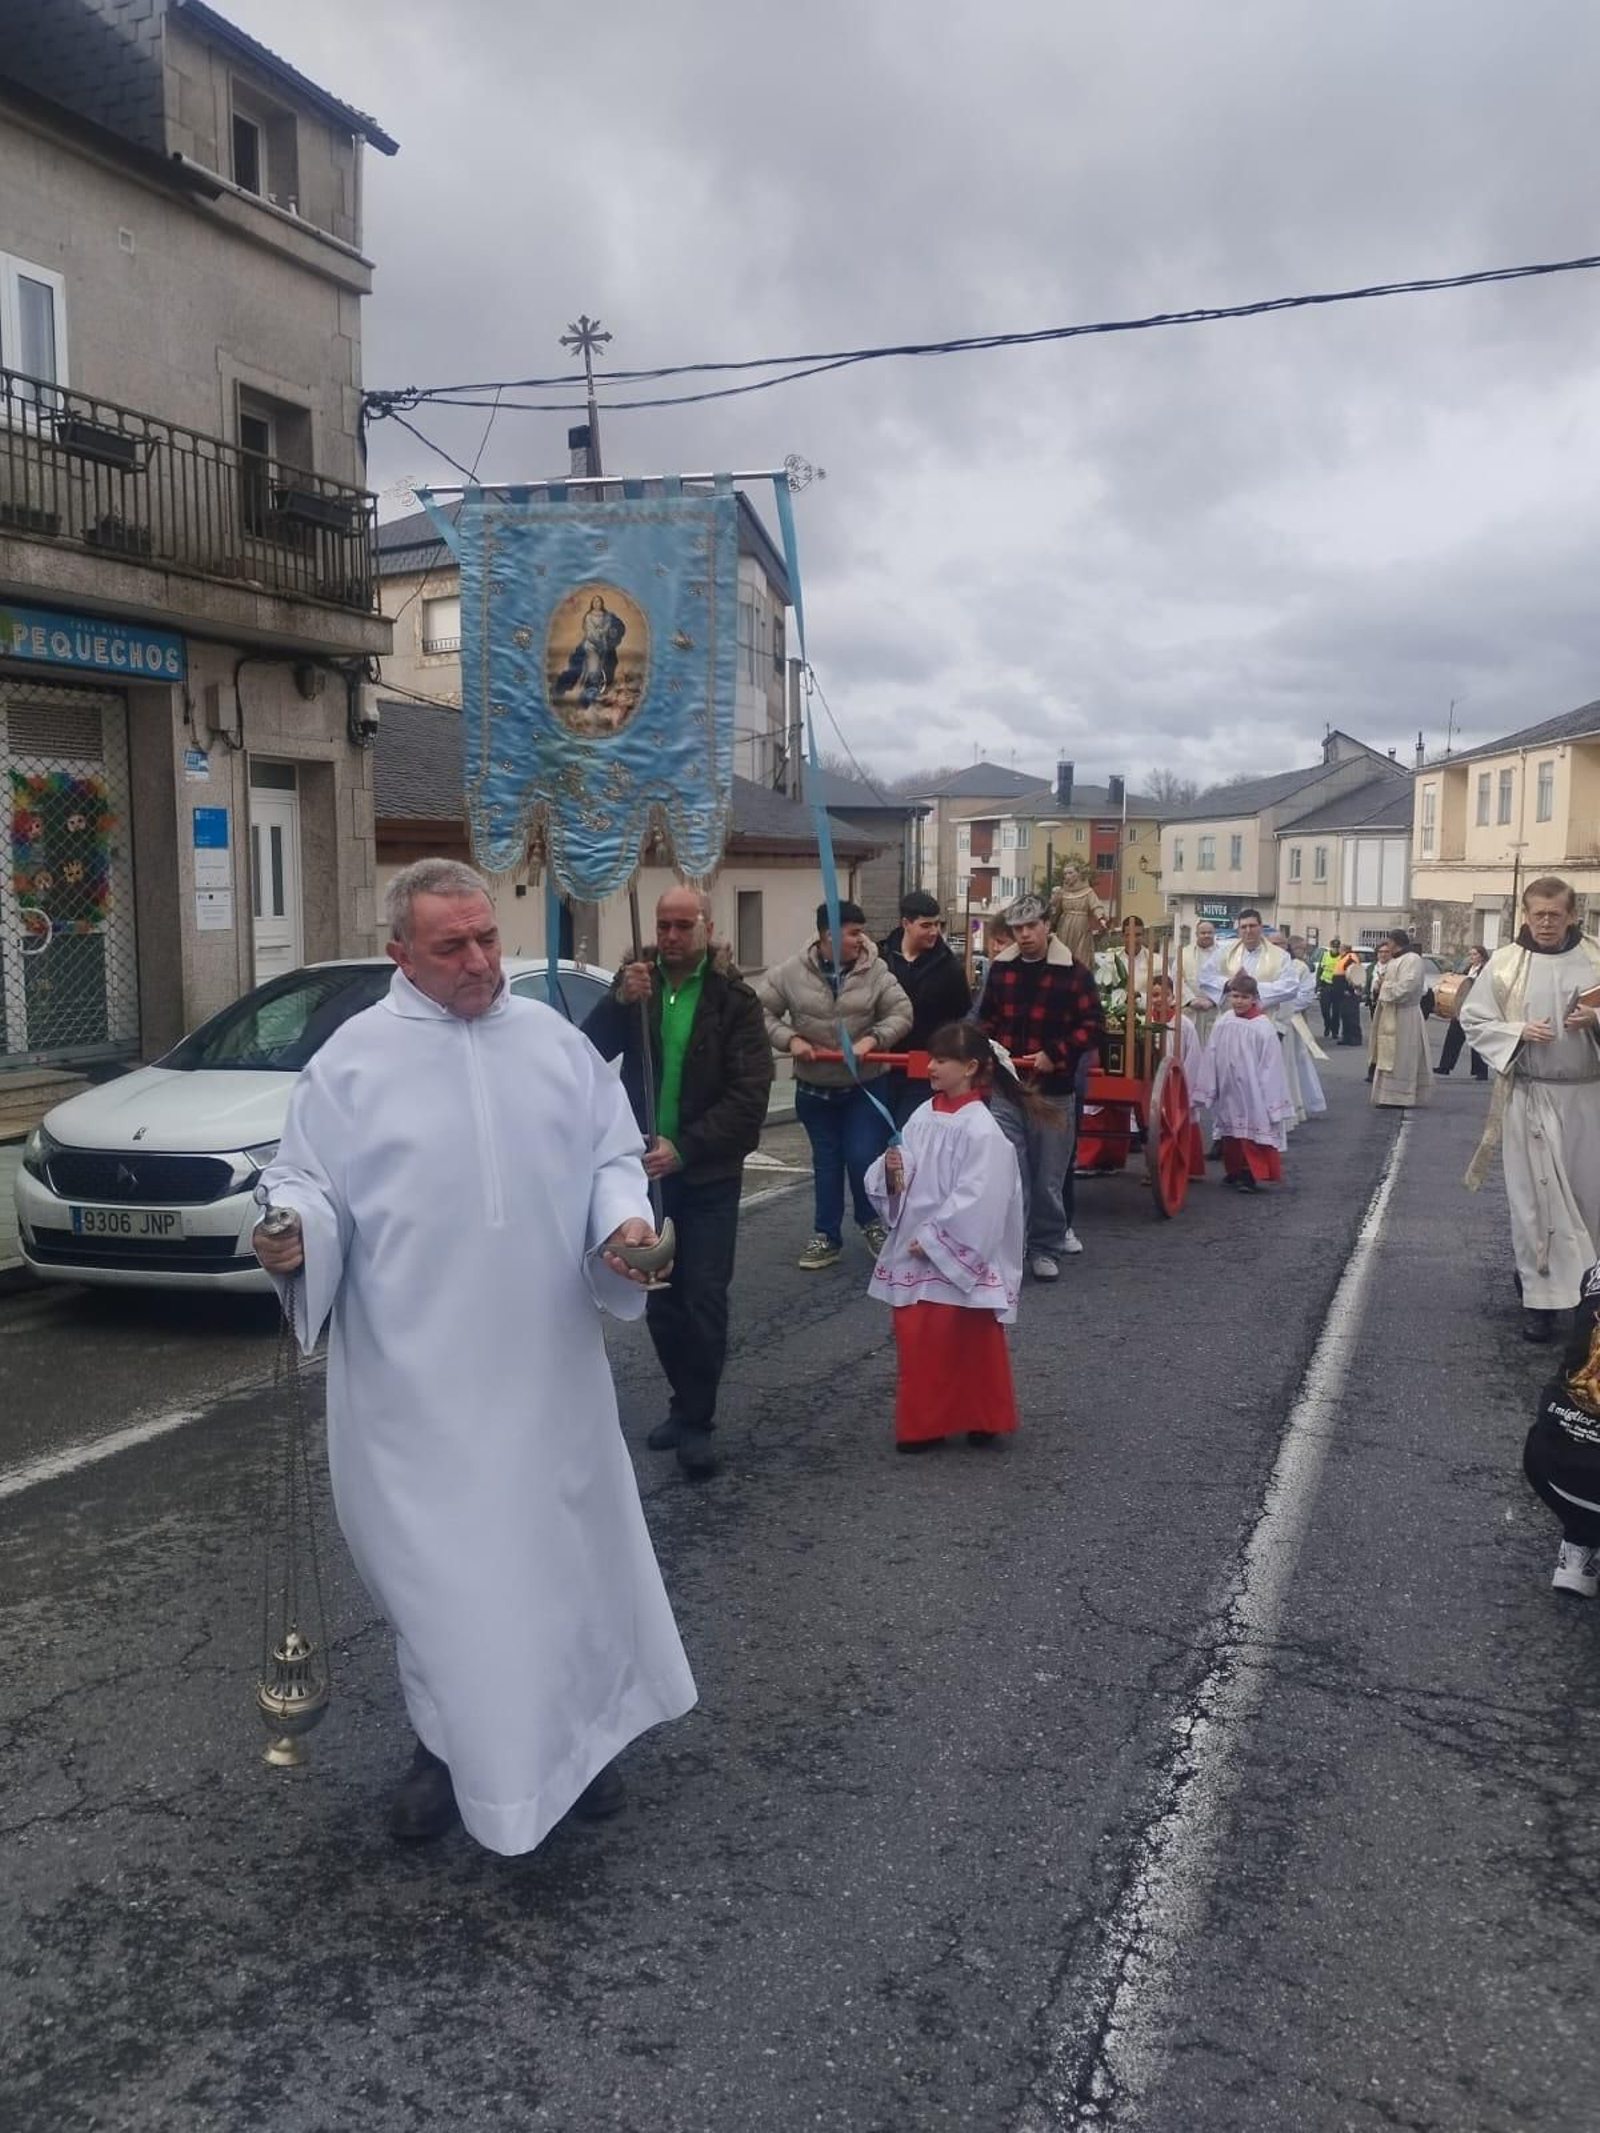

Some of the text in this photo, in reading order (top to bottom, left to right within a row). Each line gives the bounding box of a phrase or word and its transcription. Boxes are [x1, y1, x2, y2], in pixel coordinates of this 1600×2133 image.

[12, 623, 179, 674] PEQUECHOS
[84, 1211, 175, 1235] 9306 JNP
